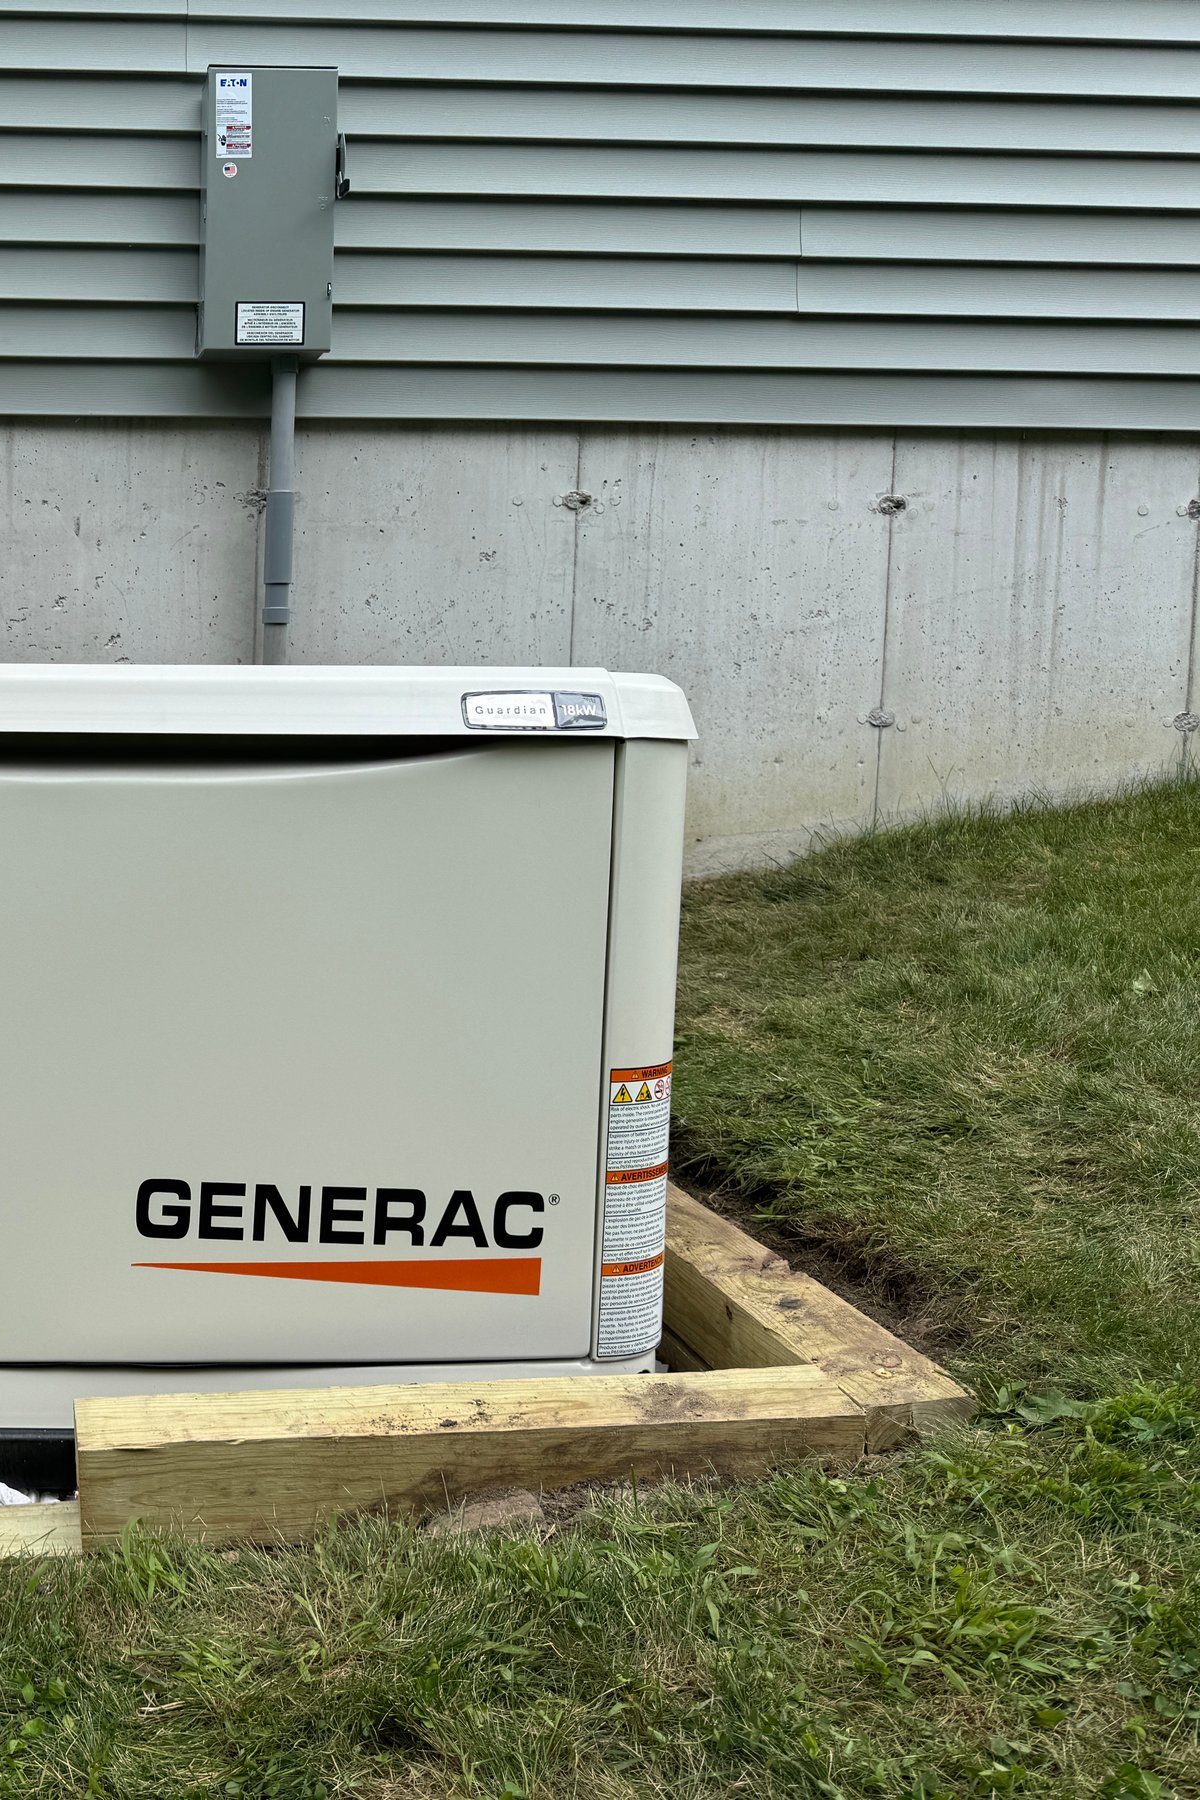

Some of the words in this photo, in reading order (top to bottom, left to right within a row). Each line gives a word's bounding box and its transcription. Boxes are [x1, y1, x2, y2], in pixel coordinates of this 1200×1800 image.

[475, 705, 546, 715] Guardian
[562, 704, 596, 716] 18kW
[609, 1123, 628, 1131] operated
[635, 1121, 649, 1129] qualified
[635, 1129, 647, 1137] battery
[608, 1150, 623, 1158] vicinity
[136, 1177, 545, 1249] GENERAC
[606, 1207, 626, 1215] personnel
[610, 1299, 627, 1307] personal
